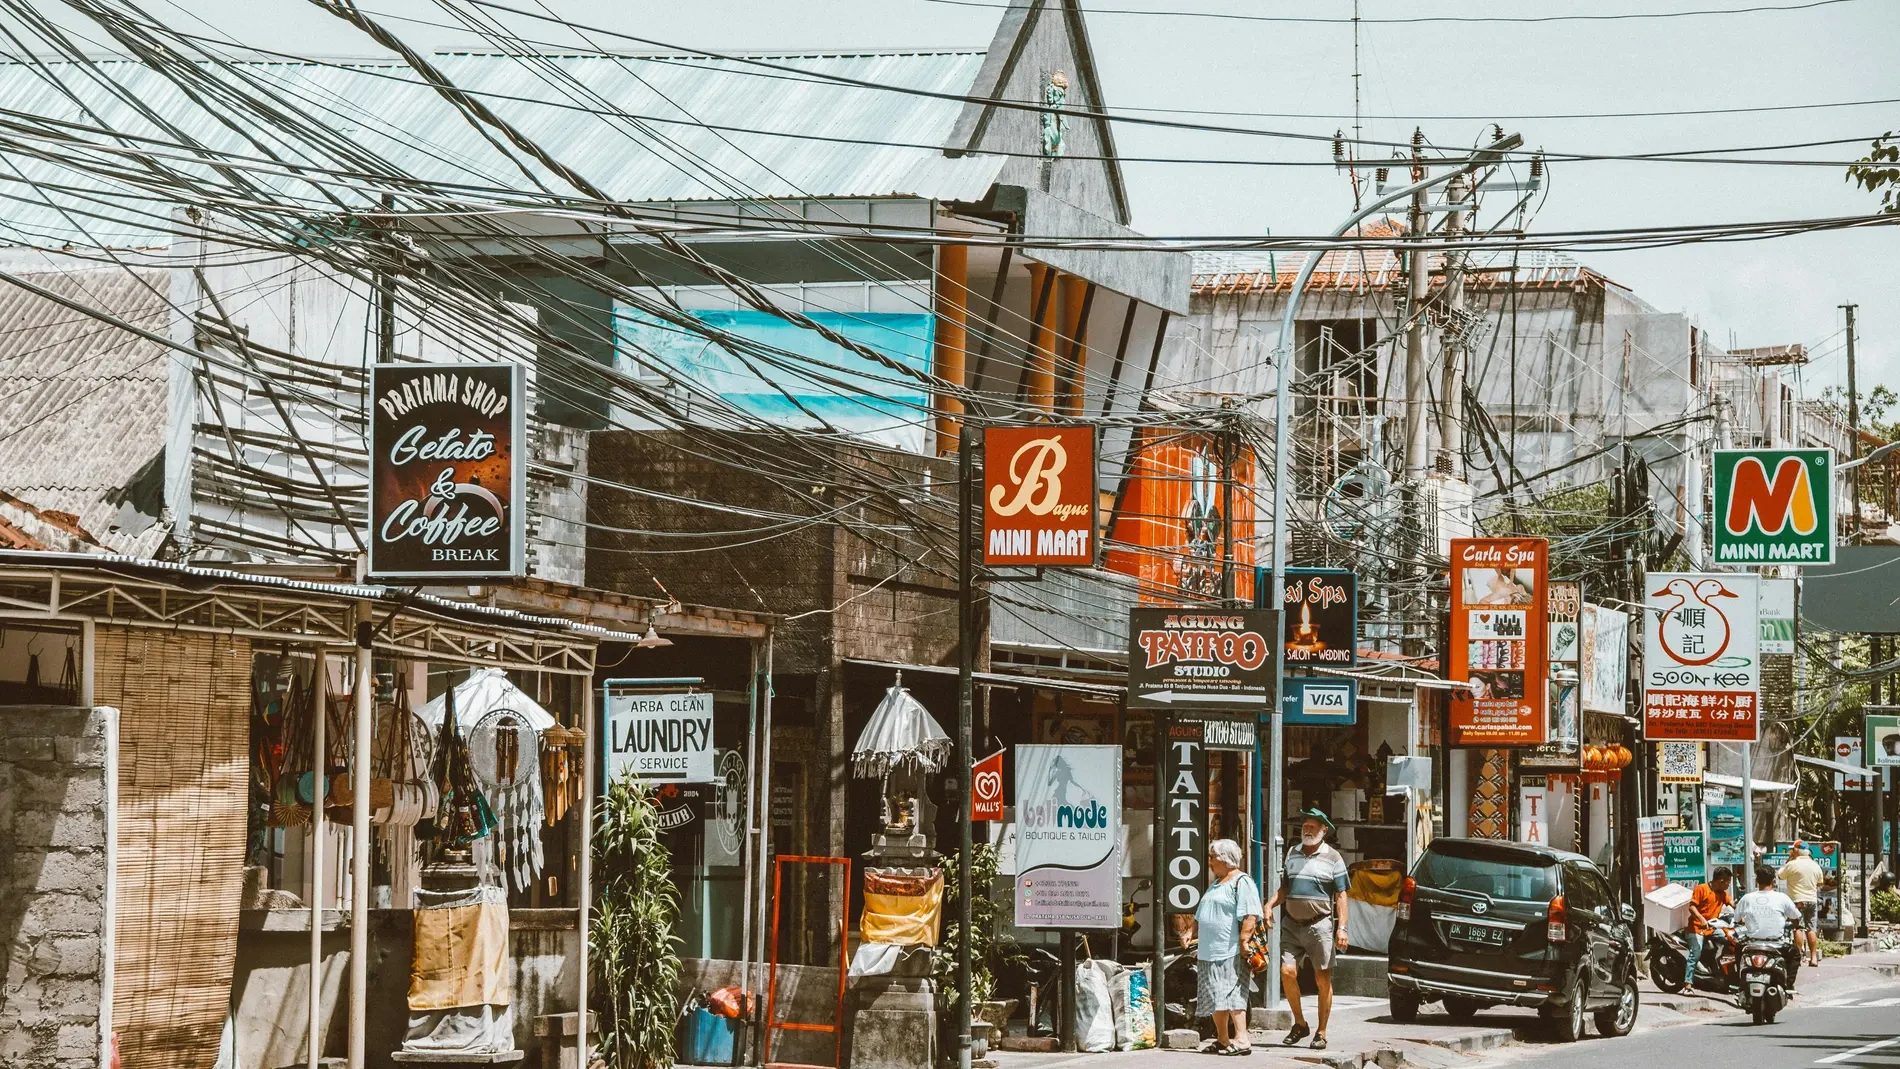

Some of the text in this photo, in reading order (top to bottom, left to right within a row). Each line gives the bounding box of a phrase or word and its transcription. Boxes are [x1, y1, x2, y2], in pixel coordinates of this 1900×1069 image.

[378, 373, 508, 420] PRATAMA SHOP
[390, 425, 496, 465] Gelato
[430, 467, 456, 500] &
[989, 434, 1088, 521] Bagus
[381, 499, 501, 545] Coffee
[989, 529, 1089, 556] MINI MART
[432, 548, 499, 561] BREAK
[1463, 545, 1535, 565] Carla Spa
[1720, 543, 1824, 560] MINI MART
[1308, 576, 1348, 610] Spa
[1164, 615, 1245, 630] AGUNG
[1138, 630, 1270, 671] TATTOO
[1287, 648, 1311, 661] SALON
[1318, 649, 1350, 662] WEDDING
[1173, 665, 1230, 677] STUDIO
[1651, 671, 1710, 687] SOON
[630, 699, 704, 713] ARBA CLEAN
[1283, 694, 1343, 706] refer VISA
[612, 718, 711, 753] LAUNDRY
[1169, 726, 1202, 737] AGUNG
[1229, 721, 1254, 745] STUDIO
[1458, 723, 1532, 732] www.carlaspabali.com
[975, 801, 1000, 812] WALL'S
[1169, 741, 1202, 909] TATTOO
[1025, 831, 1107, 841] BOUTIQUE & TAILOR
[1468, 925, 1487, 938] 1869
